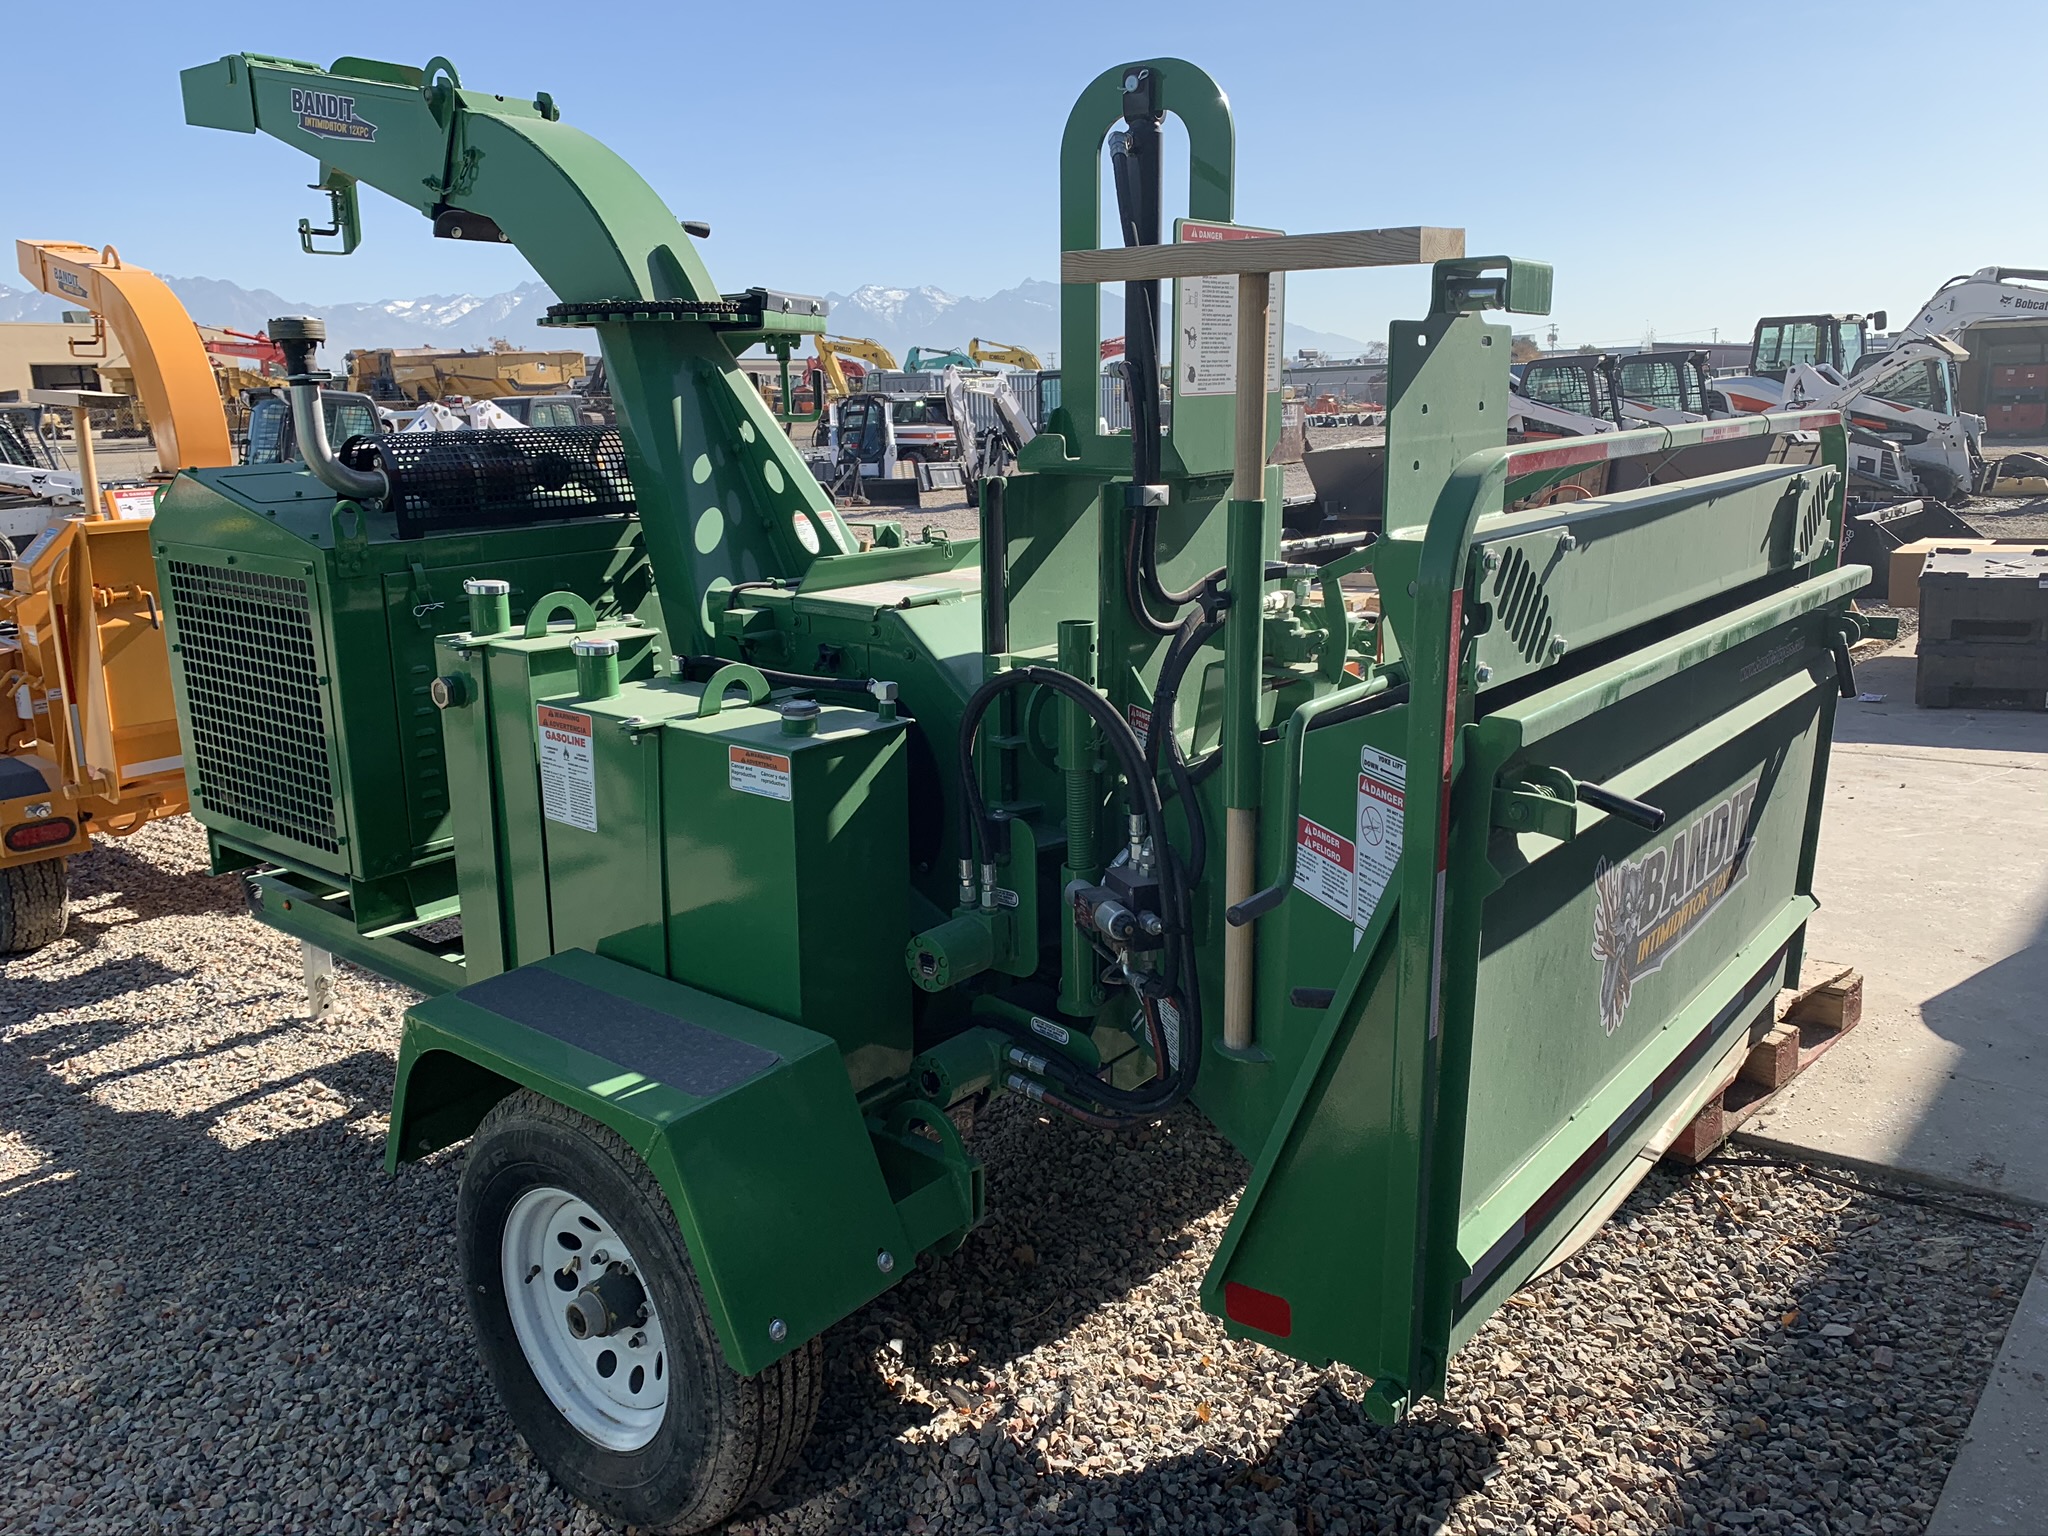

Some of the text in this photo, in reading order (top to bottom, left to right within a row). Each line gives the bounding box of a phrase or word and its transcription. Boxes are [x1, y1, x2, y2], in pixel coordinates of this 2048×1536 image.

[290, 88, 355, 122] BANDIT
[304, 117, 369, 137] INTIMIDATOR 12XPC
[1198, 230, 1223, 240] DANGER
[53, 267, 78, 287] BANDIT
[2015, 298, 2048, 310] Bobcat
[554, 711, 580, 722] WARNING
[549, 720, 586, 734] ADVERTENCIA
[545, 730, 586, 748] GASOLINE
[1363, 760, 1379, 771] DOWN
[1378, 755, 1403, 771] YOKE LIFT
[731, 769, 756, 779] Reproductive
[1370, 784, 1404, 808] DANGER
[1312, 827, 1340, 848] DANGER
[1312, 840, 1341, 862] PELIGRO
[1637, 780, 1757, 937] BANDIT
[1636, 887, 1708, 965] INTIMIDATOR
